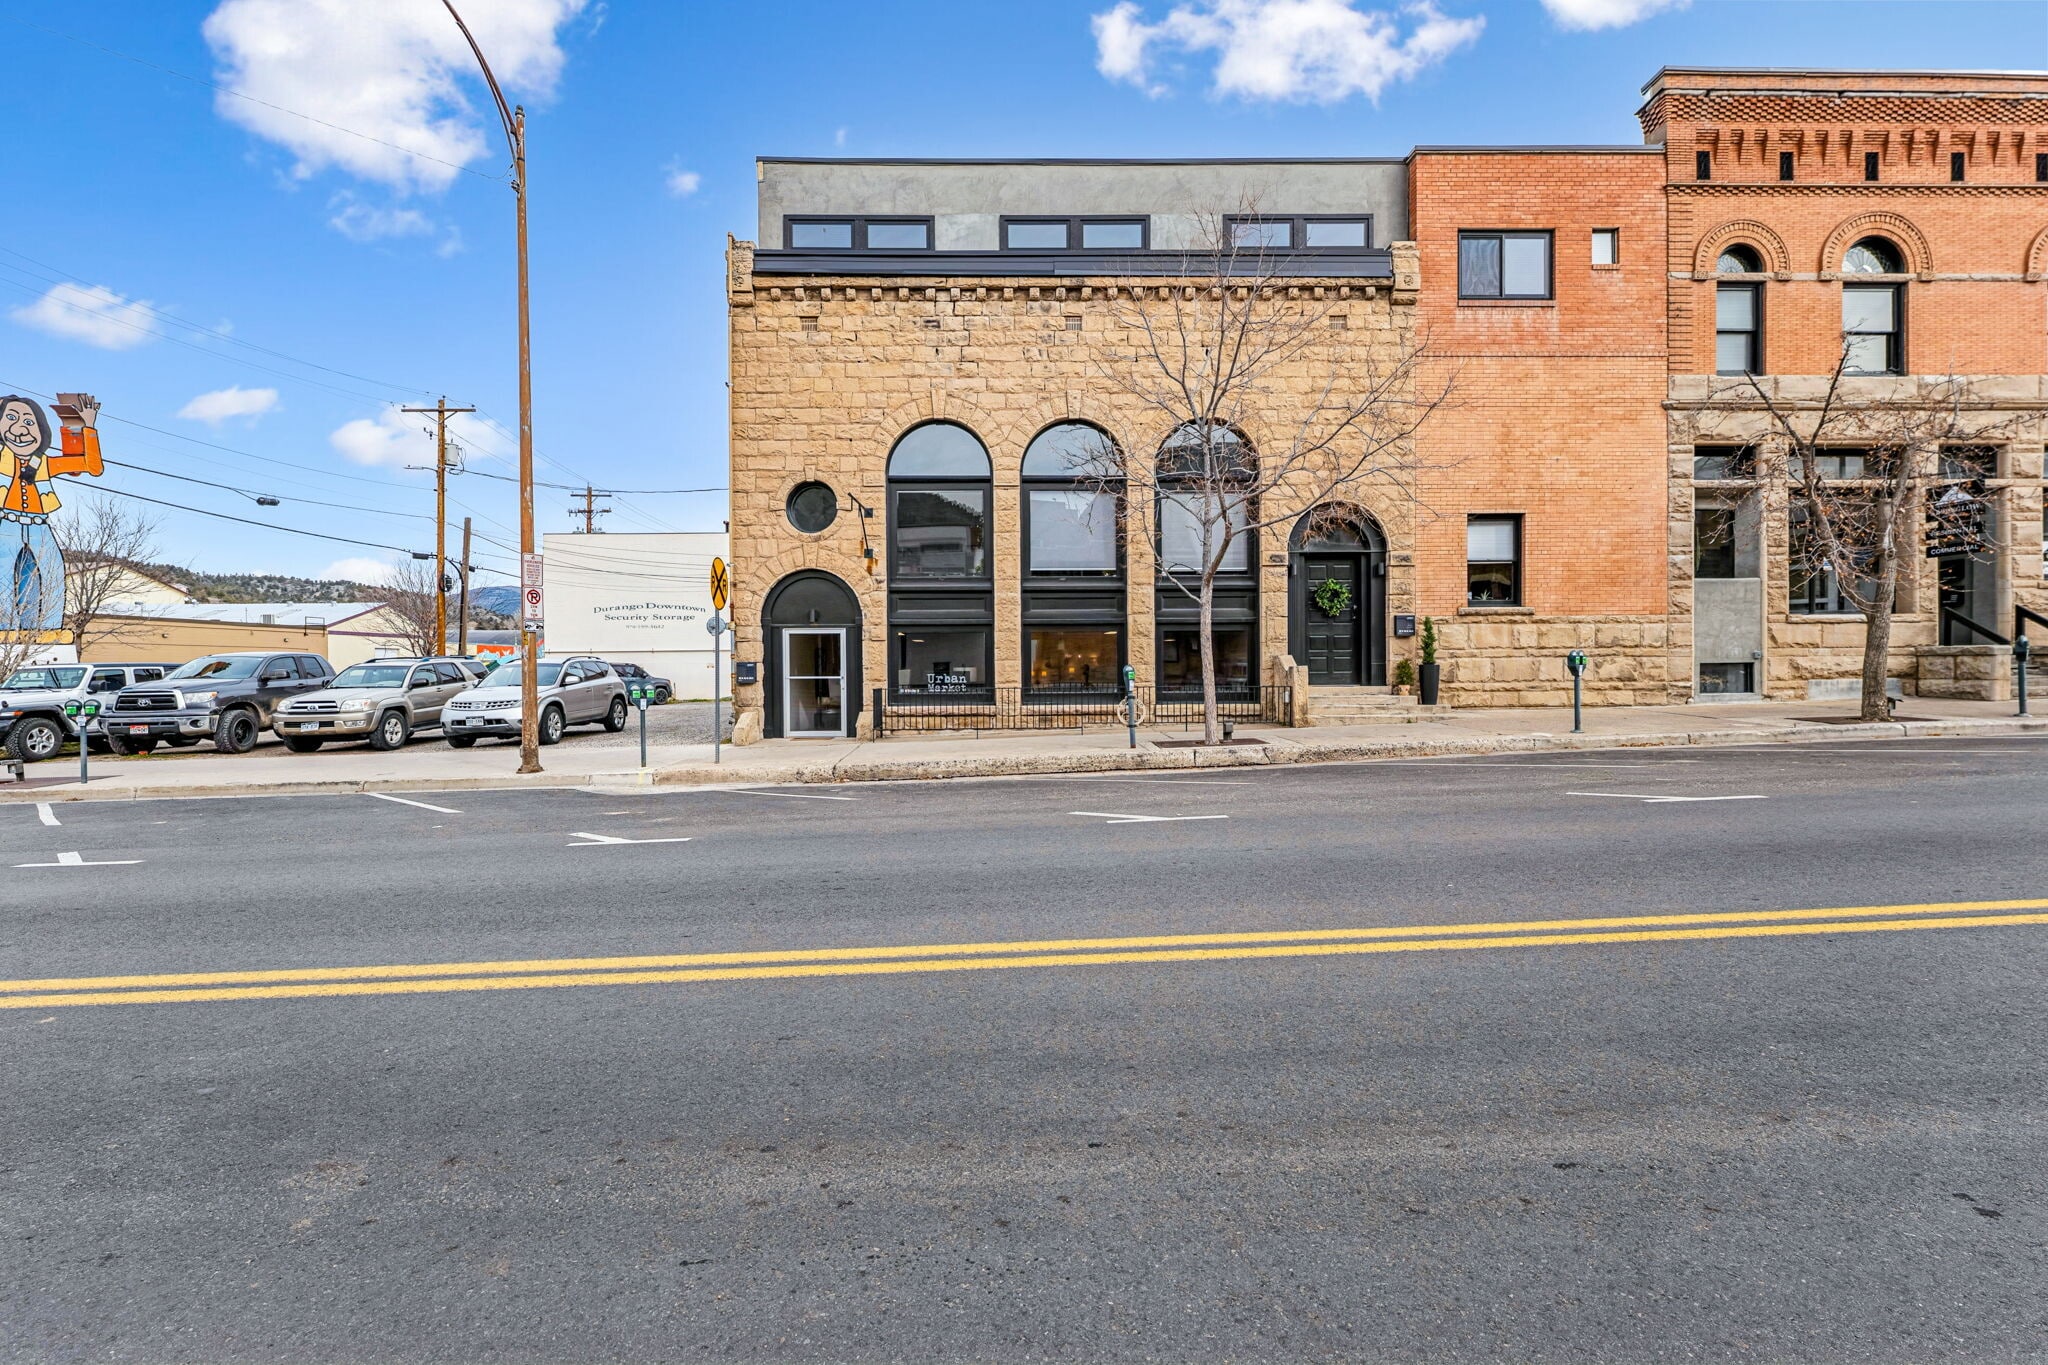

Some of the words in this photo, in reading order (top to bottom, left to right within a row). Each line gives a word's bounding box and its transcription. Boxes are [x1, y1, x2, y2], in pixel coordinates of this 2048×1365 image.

[593, 603, 644, 614] Durango
[646, 602, 707, 613] Downtown
[604, 614, 649, 622] Security
[652, 614, 696, 622] Storage
[926, 673, 967, 684] Urban
[927, 683, 967, 692] Market
